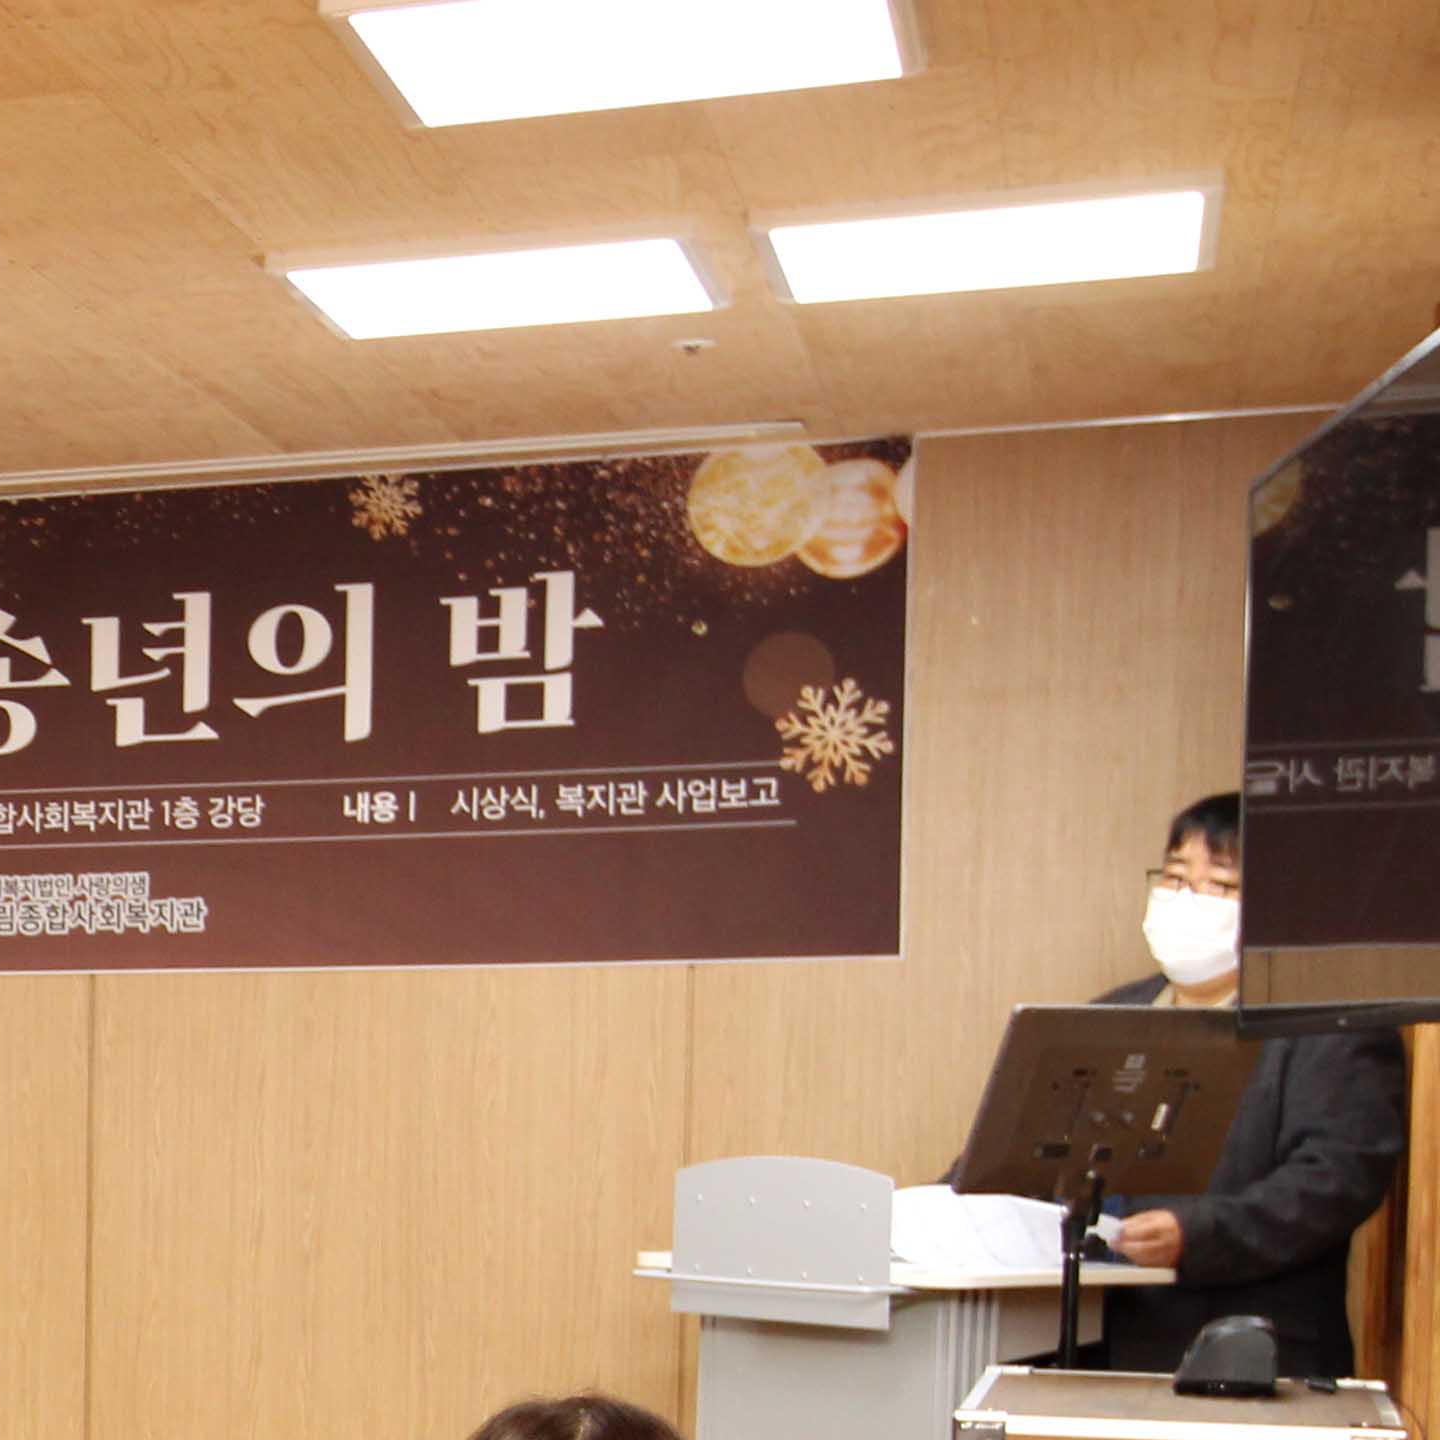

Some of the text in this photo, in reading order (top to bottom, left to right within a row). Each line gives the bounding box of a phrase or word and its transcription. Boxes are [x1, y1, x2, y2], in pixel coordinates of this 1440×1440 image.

[440, 570, 604, 734] 밤
[161, 798, 201, 829] 1층
[207, 795, 265, 829] 강당
[343, 792, 399, 823] 내용
[450, 786, 546, 821] 시상식,
[554, 782, 647, 816] 복지관
[656, 777, 781, 813] 사업보고
[76, 872, 149, 898] 사랑의샘
